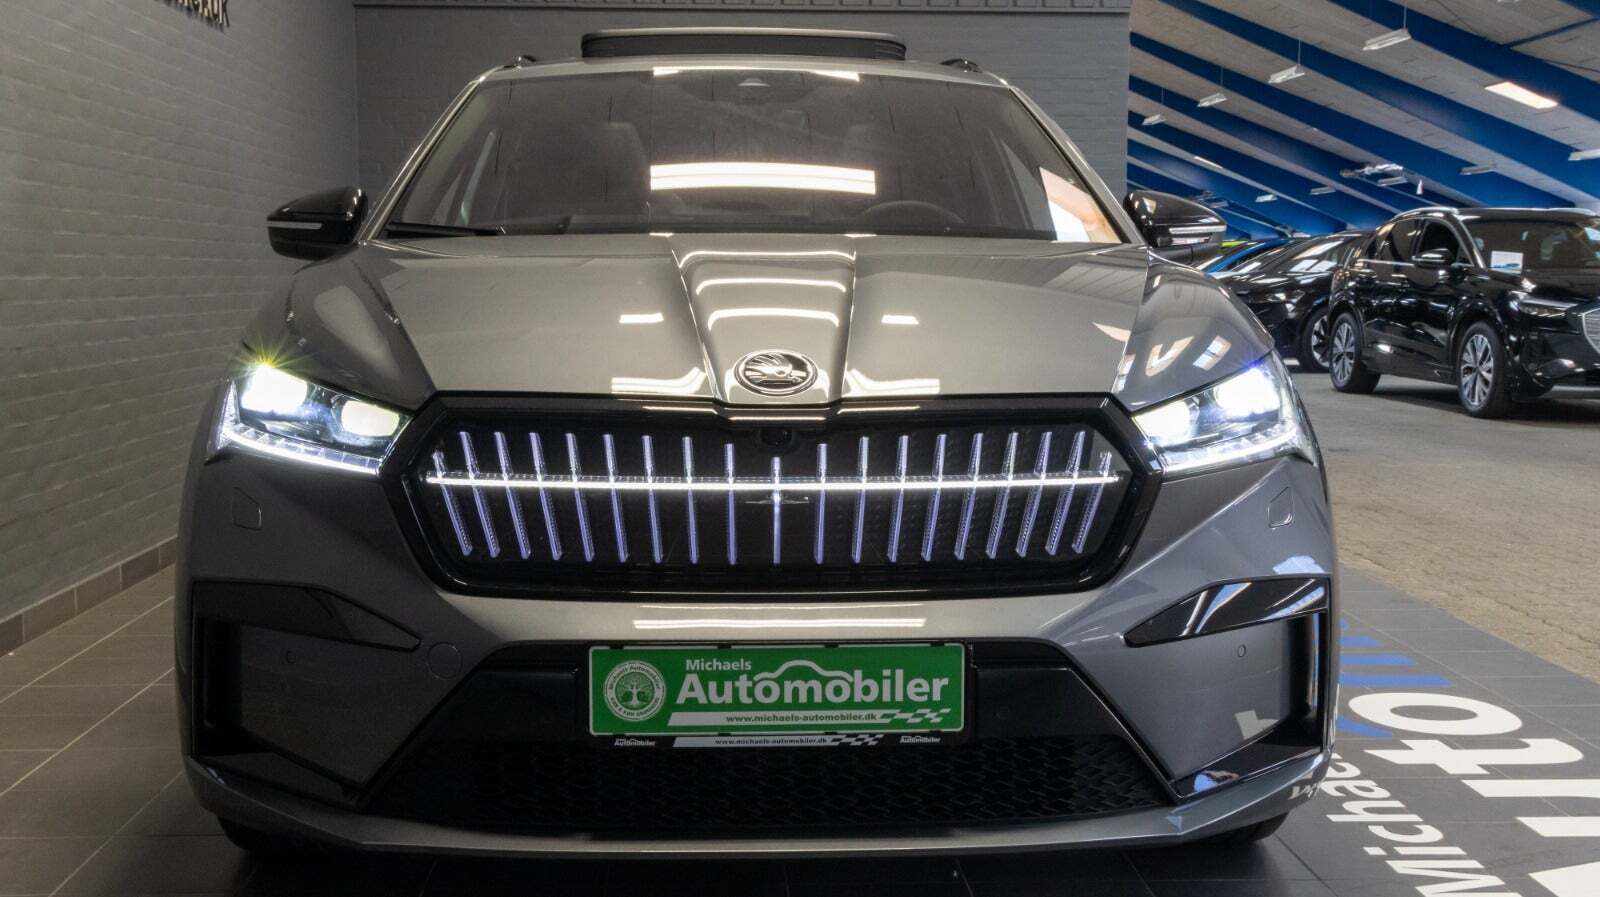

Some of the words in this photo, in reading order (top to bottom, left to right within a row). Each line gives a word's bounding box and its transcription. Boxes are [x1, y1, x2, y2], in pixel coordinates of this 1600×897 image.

[685, 659, 752, 671] Michaels
[676, 669, 949, 704] Automobiler
[725, 711, 878, 723] www.michaels-automobiler.dk
[1320, 752, 1525, 897] Michae
